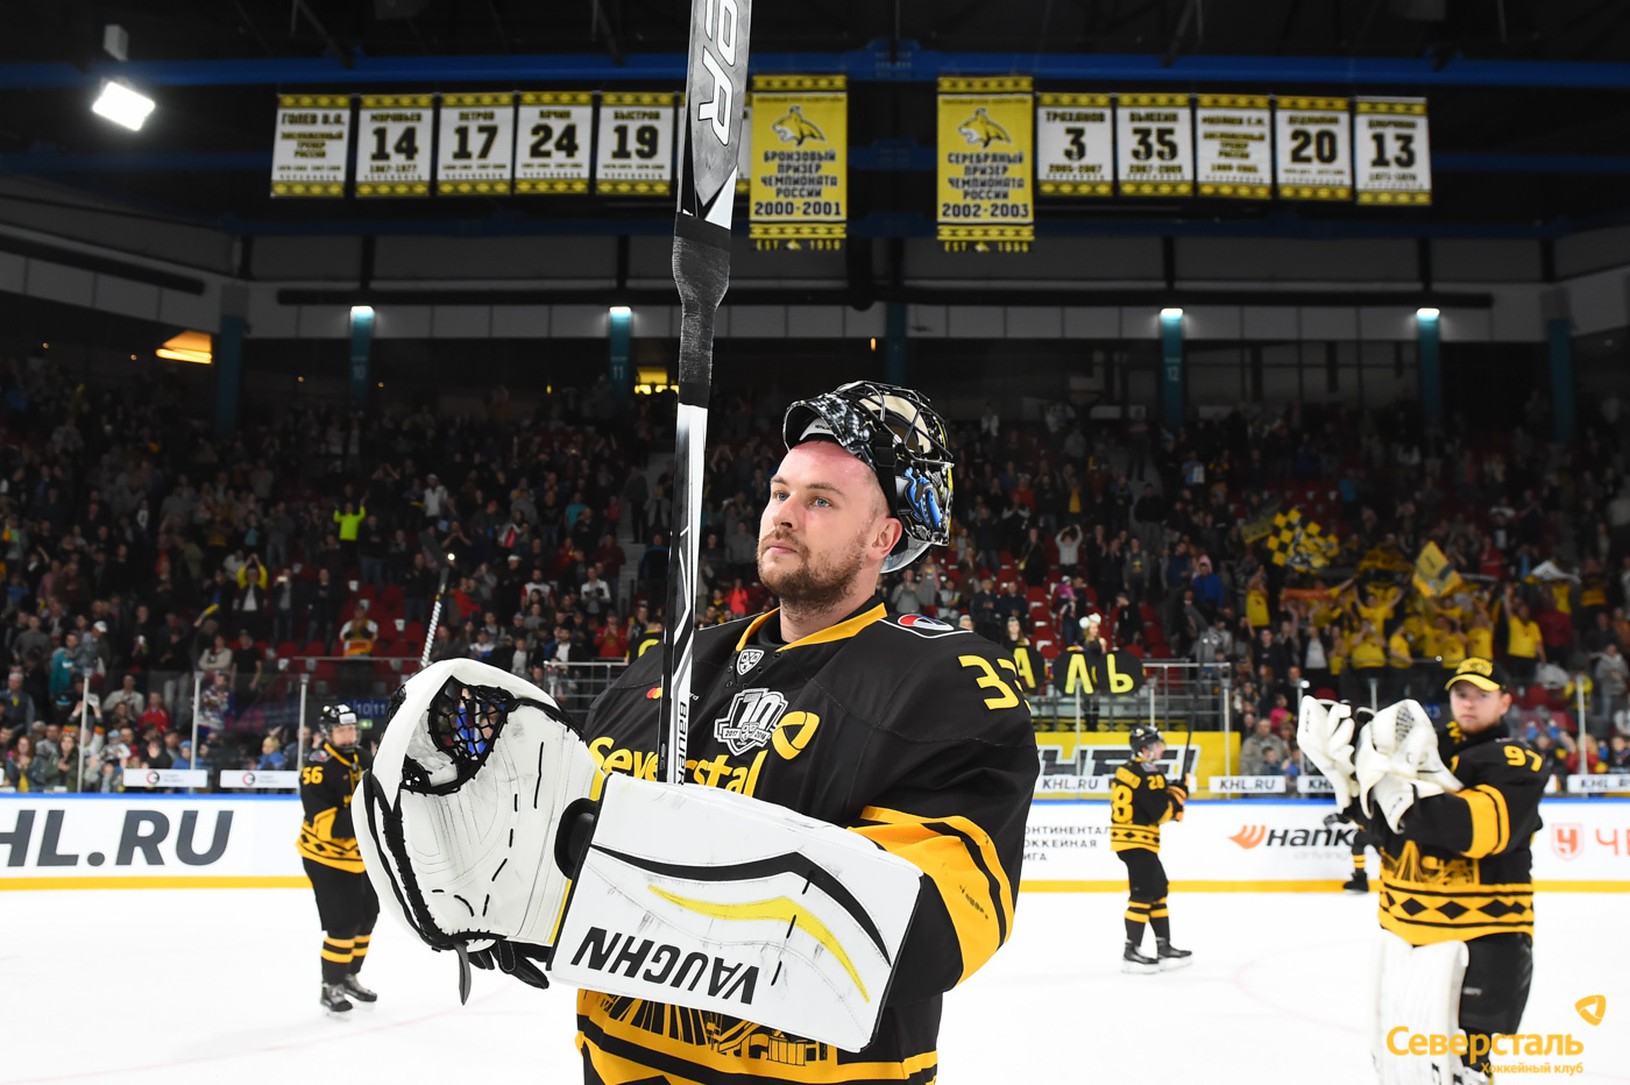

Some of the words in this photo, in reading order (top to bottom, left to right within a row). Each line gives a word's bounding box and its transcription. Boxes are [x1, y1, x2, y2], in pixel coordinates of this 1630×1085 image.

[370, 126, 419, 161] 14
[453, 125, 498, 160] 17
[530, 123, 578, 158] 24
[611, 124, 659, 160] 19
[1064, 127, 1086, 161] 3
[1131, 127, 1178, 161] 35
[1290, 129, 1338, 164] 20
[764, 150, 836, 162] БРОНЗОВЫЙ
[948, 152, 1024, 164] СЕРЕБРЯНЫЙ
[1370, 132, 1416, 168] 13
[777, 163, 822, 174] ПРИЗЕР
[963, 165, 1009, 176] ПРИЗЕР
[761, 175, 837, 187] ЧЕМПИОНАТА
[947, 177, 1025, 188] ЧЕМПИОНАТА
[776, 188, 821, 198] РОССИИ
[963, 190, 1009, 200] РОССИИ
[755, 202, 841, 216] 2000-2001
[942, 203, 1029, 218] 2002-2003
[1503, 745, 1543, 772] 97
[302, 766, 324, 785] 56
[1219, 776, 1275, 790] KHL.RU
[1042, 779, 1099, 790] KHL.RU
[1111, 783, 1133, 823] 8
[570, 926, 760, 1005] VAUGHN
